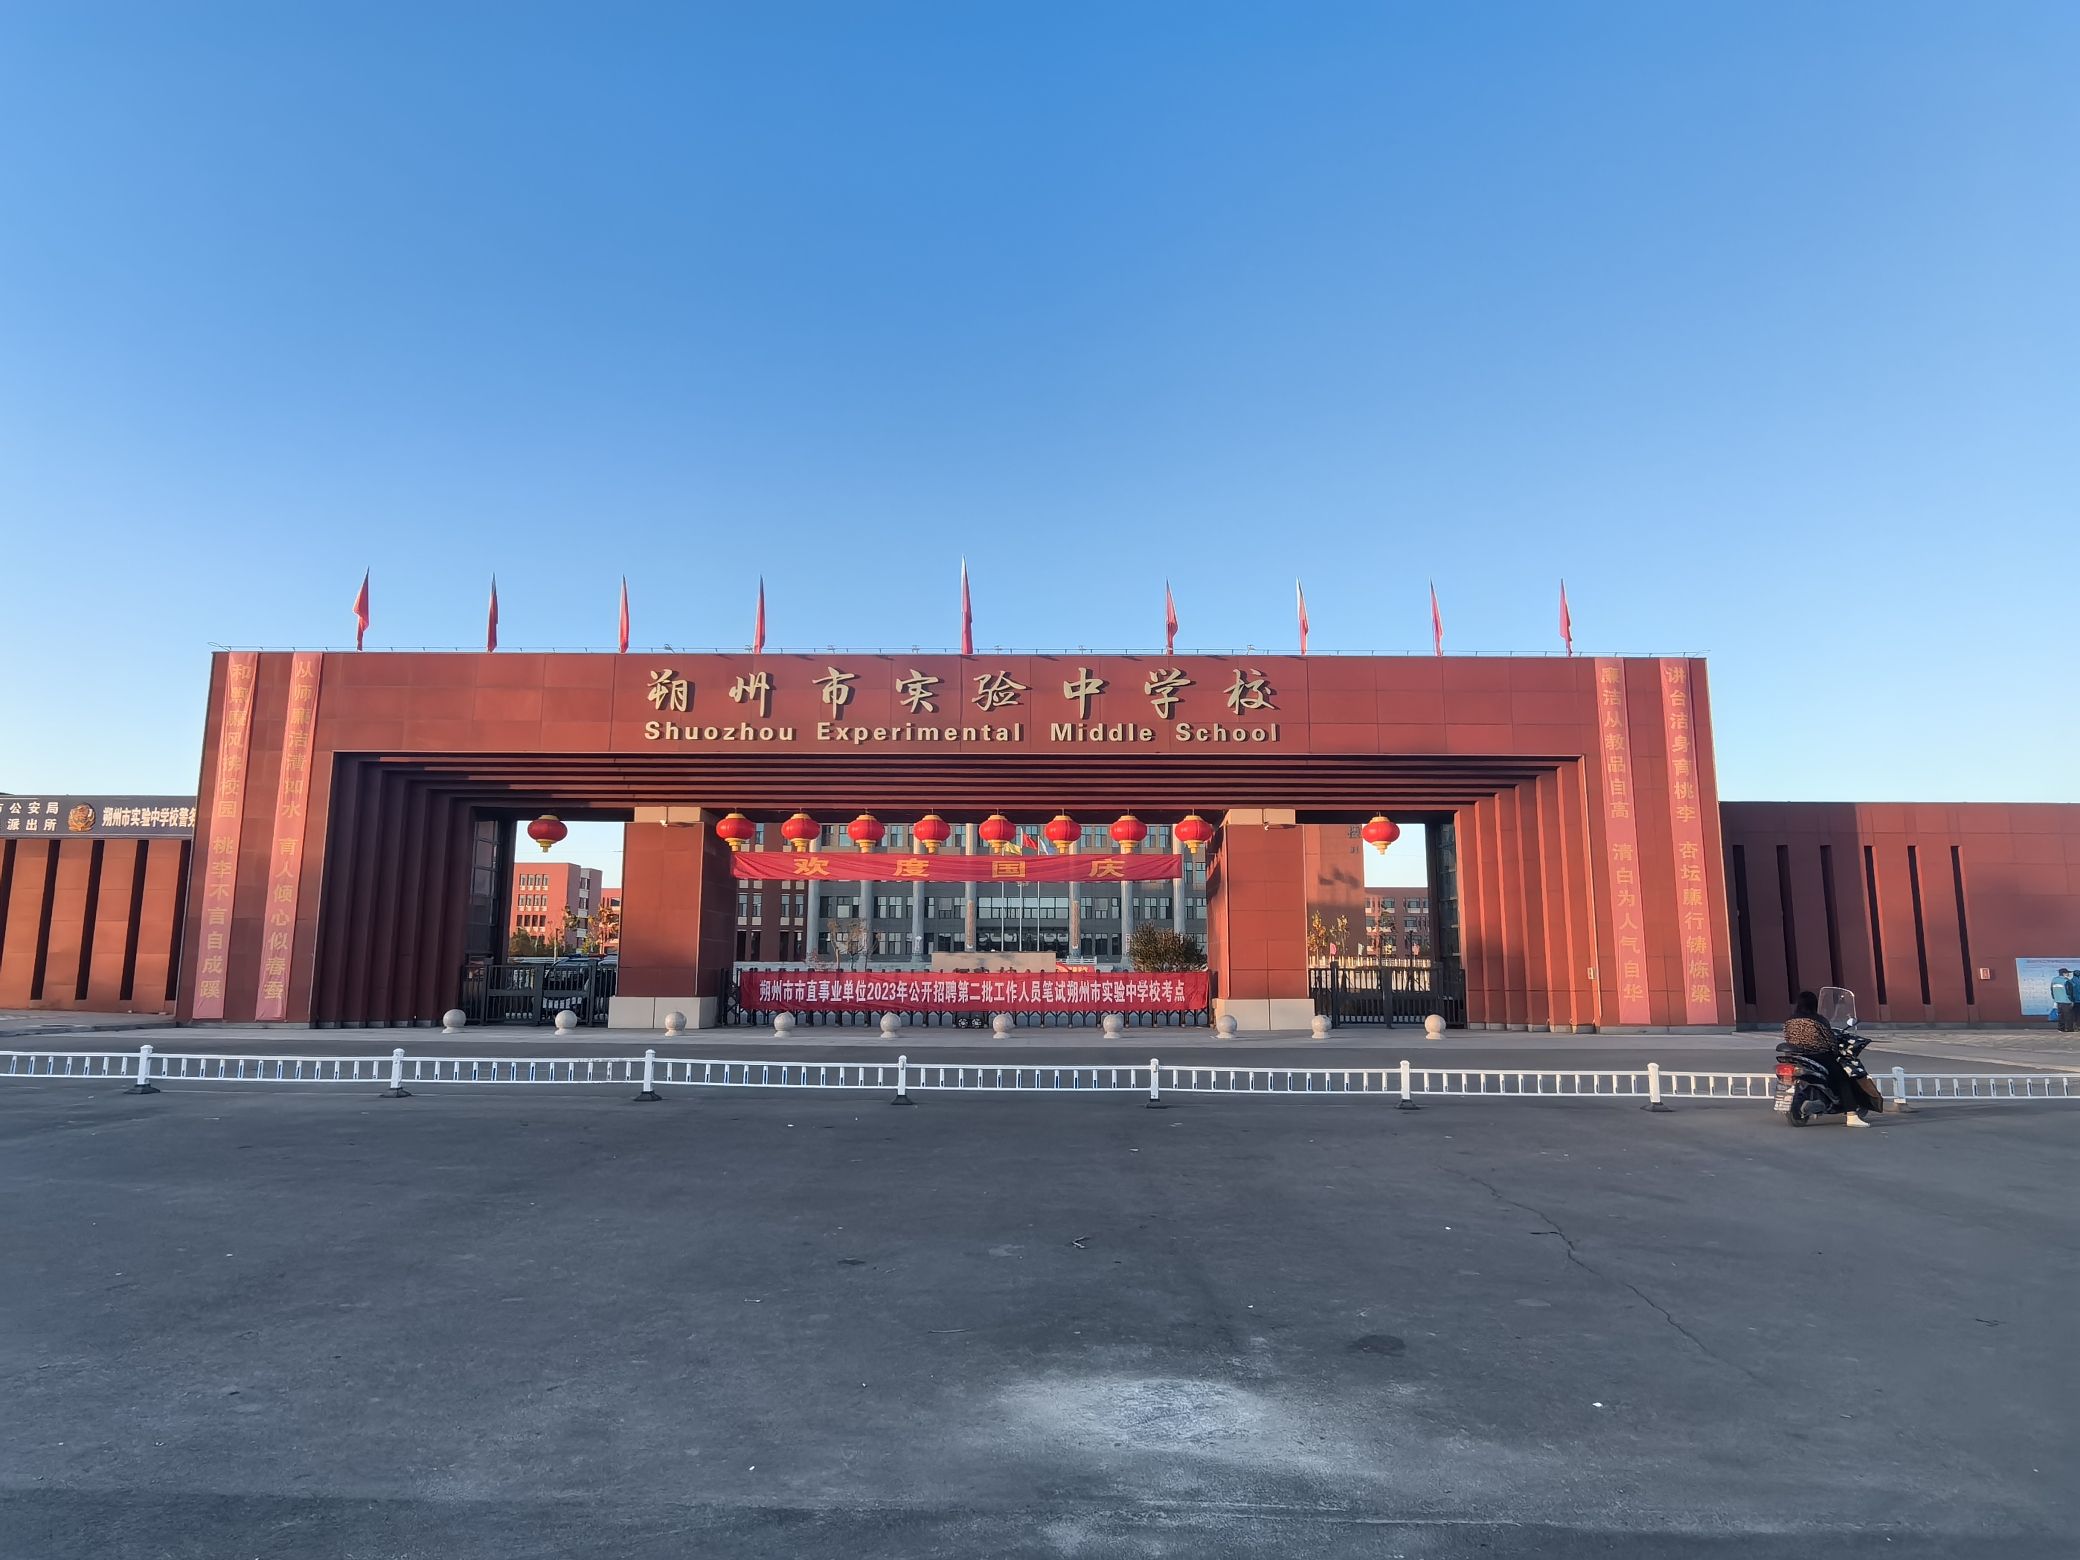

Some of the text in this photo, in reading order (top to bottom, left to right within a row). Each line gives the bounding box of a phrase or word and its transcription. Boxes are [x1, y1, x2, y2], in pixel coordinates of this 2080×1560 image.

[647, 667, 1279, 719] 朔州市实验中学校
[644, 721, 1280, 745] Shuozhou Experimental Middle School
[6, 818, 57, 831] 派出所
[793, 857, 1125, 878] 欢度国庆
